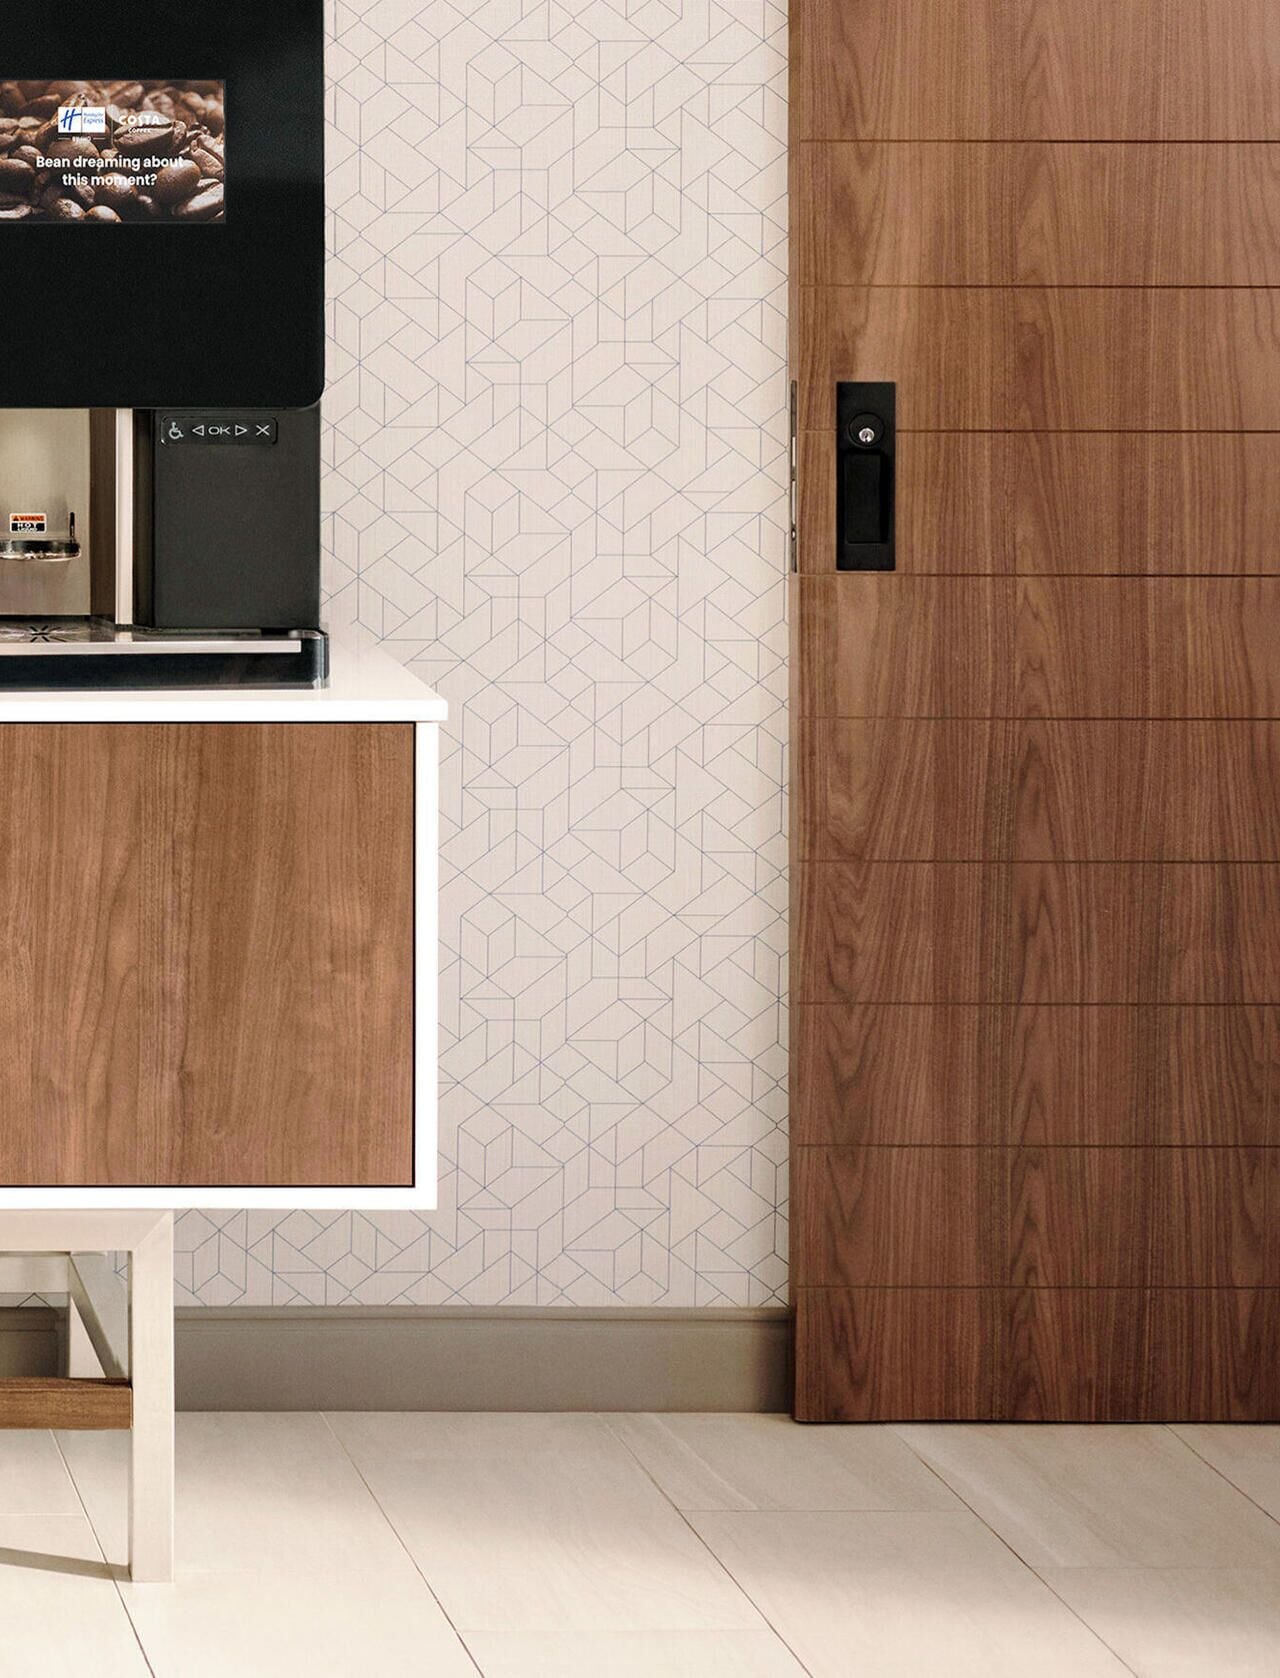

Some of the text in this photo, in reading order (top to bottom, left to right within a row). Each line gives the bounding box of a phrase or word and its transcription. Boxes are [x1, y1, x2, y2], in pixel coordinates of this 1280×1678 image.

[118, 115, 160, 127] COSTA
[36, 156, 183, 171] Bean dreaming about
[62, 174, 158, 186] this moment?
[208, 426, 231, 435] OK
